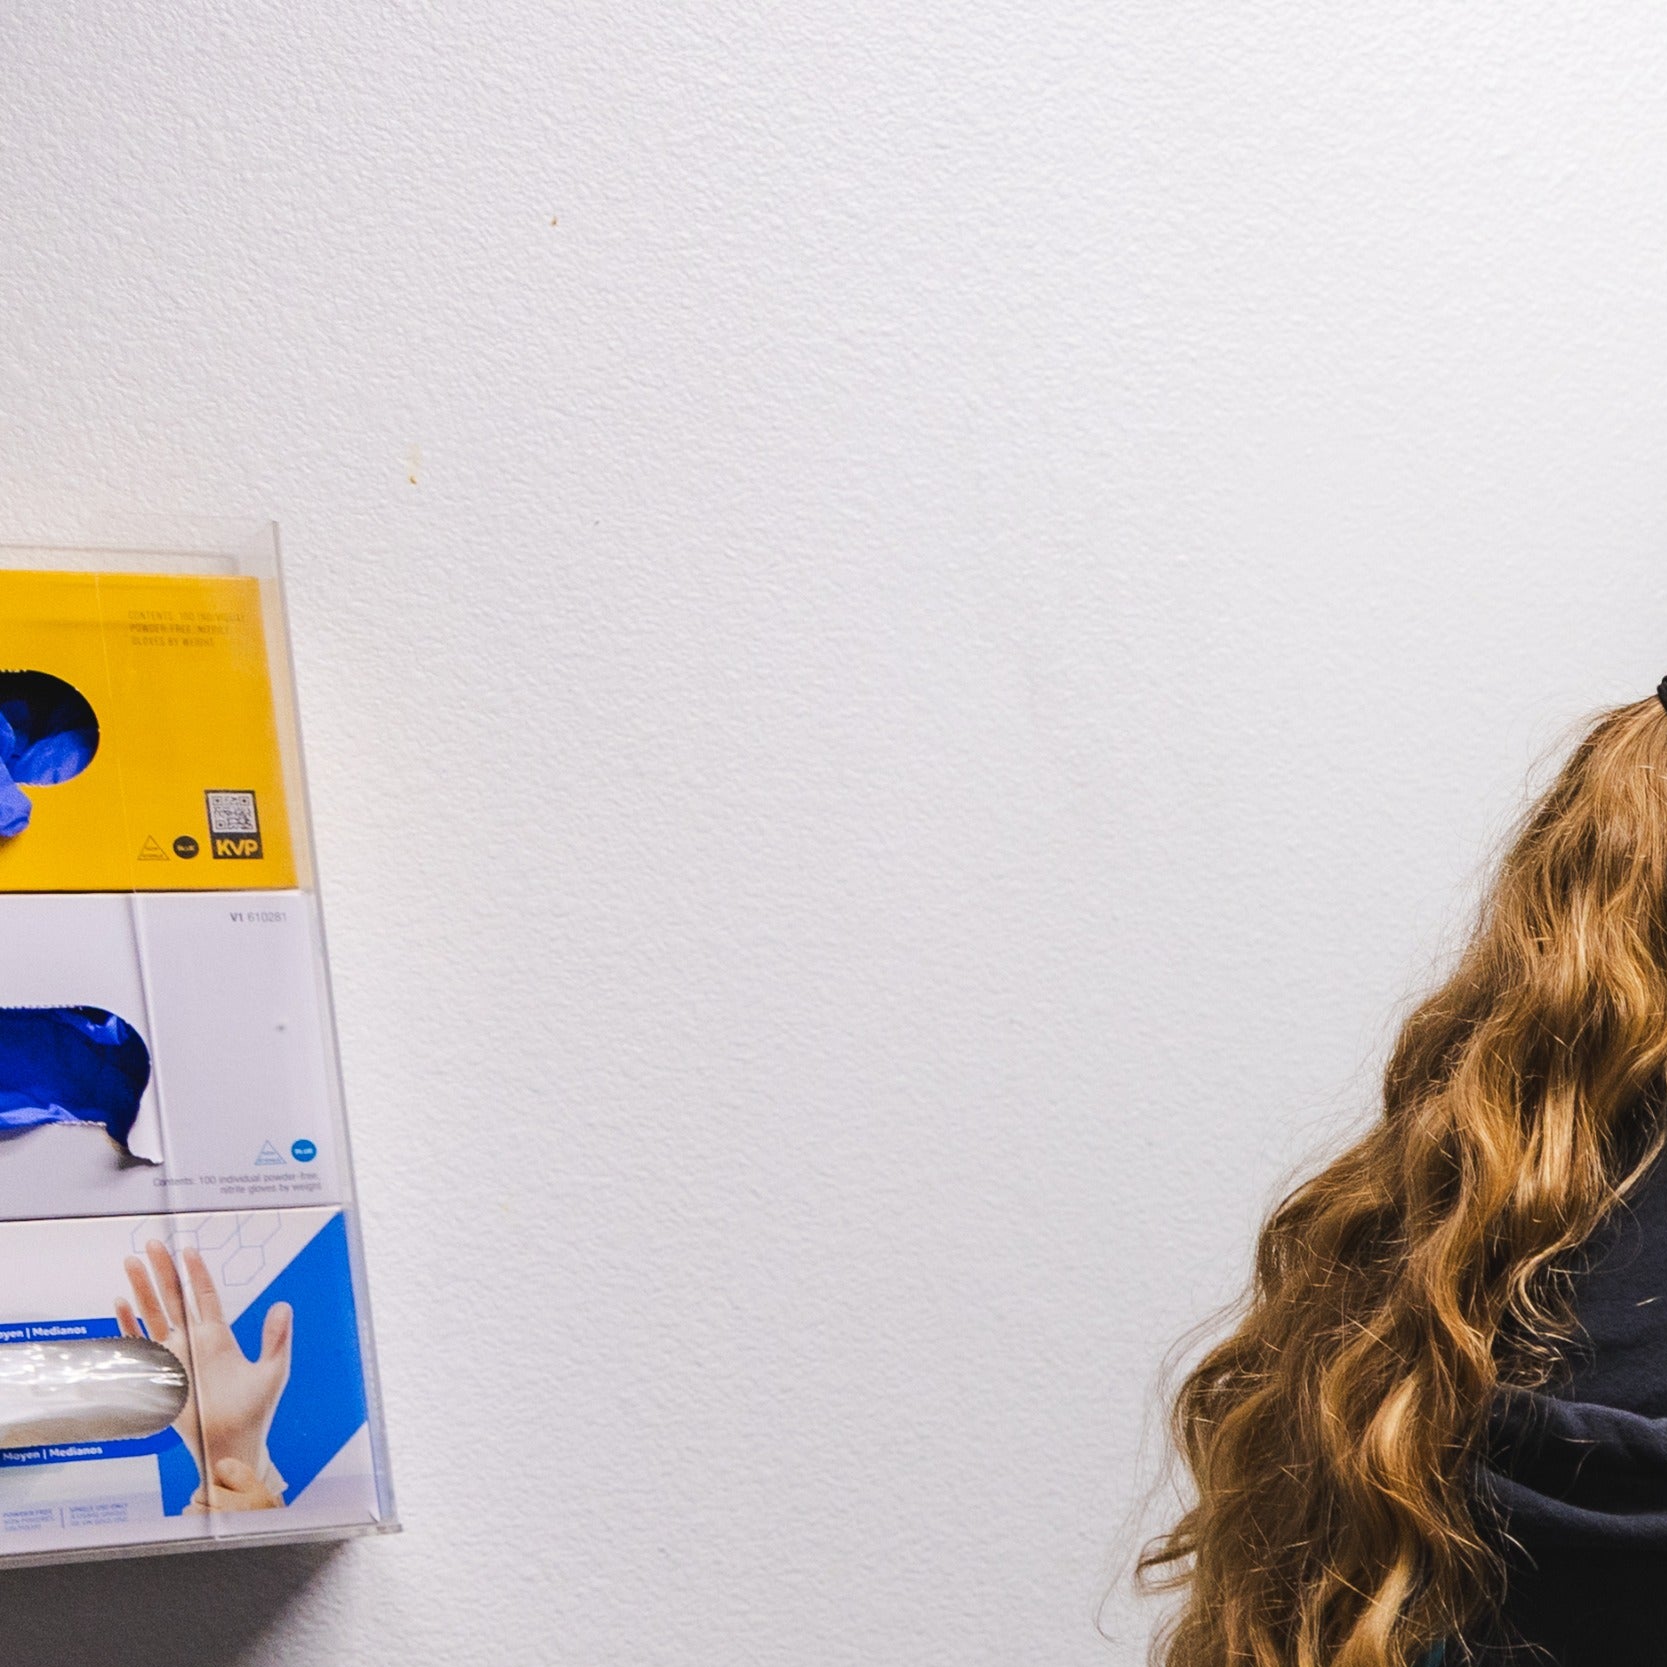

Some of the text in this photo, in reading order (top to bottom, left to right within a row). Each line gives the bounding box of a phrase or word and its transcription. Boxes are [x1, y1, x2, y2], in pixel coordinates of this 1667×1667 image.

[216, 839, 259, 856] KVP
[247, 911, 287, 922] 610281
[200, 1174, 217, 1185] 100
[219, 1174, 261, 1184] individual
[250, 1183, 278, 1195] gloves
[279, 1182, 290, 1193] by
[292, 1181, 321, 1193] weight
[0, 1326, 88, 1341] oyen Medianos
[3, 1446, 103, 1462] Moyen Medianos
